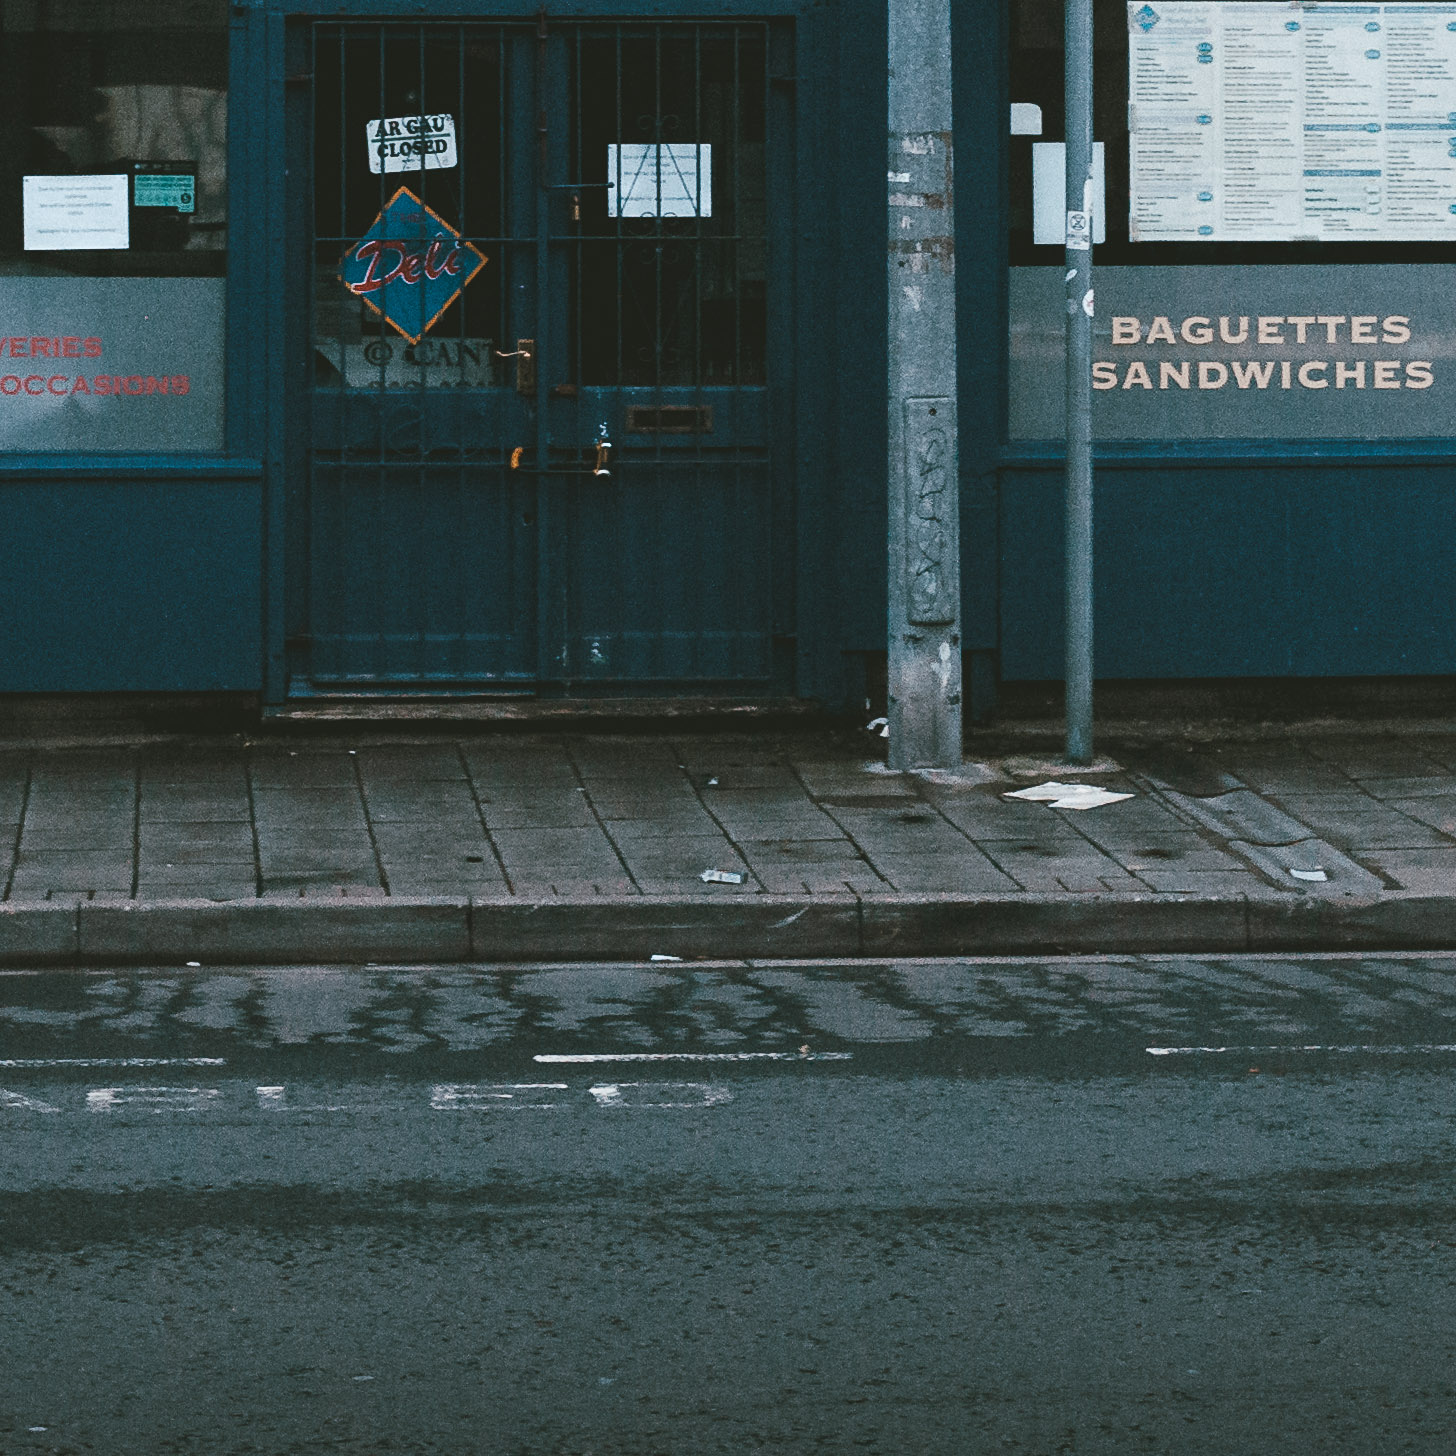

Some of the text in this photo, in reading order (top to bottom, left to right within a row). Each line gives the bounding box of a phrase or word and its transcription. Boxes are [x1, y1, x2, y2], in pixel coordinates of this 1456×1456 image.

[374, 116, 446, 138] AR GAU
[376, 138, 448, 158] CLOSED
[350, 231, 462, 294] Deli
[1111, 315, 1412, 345] BAGUETTES
[0, 374, 191, 397] OCCASIONS
[1091, 360, 1435, 391] SANDWICHES
